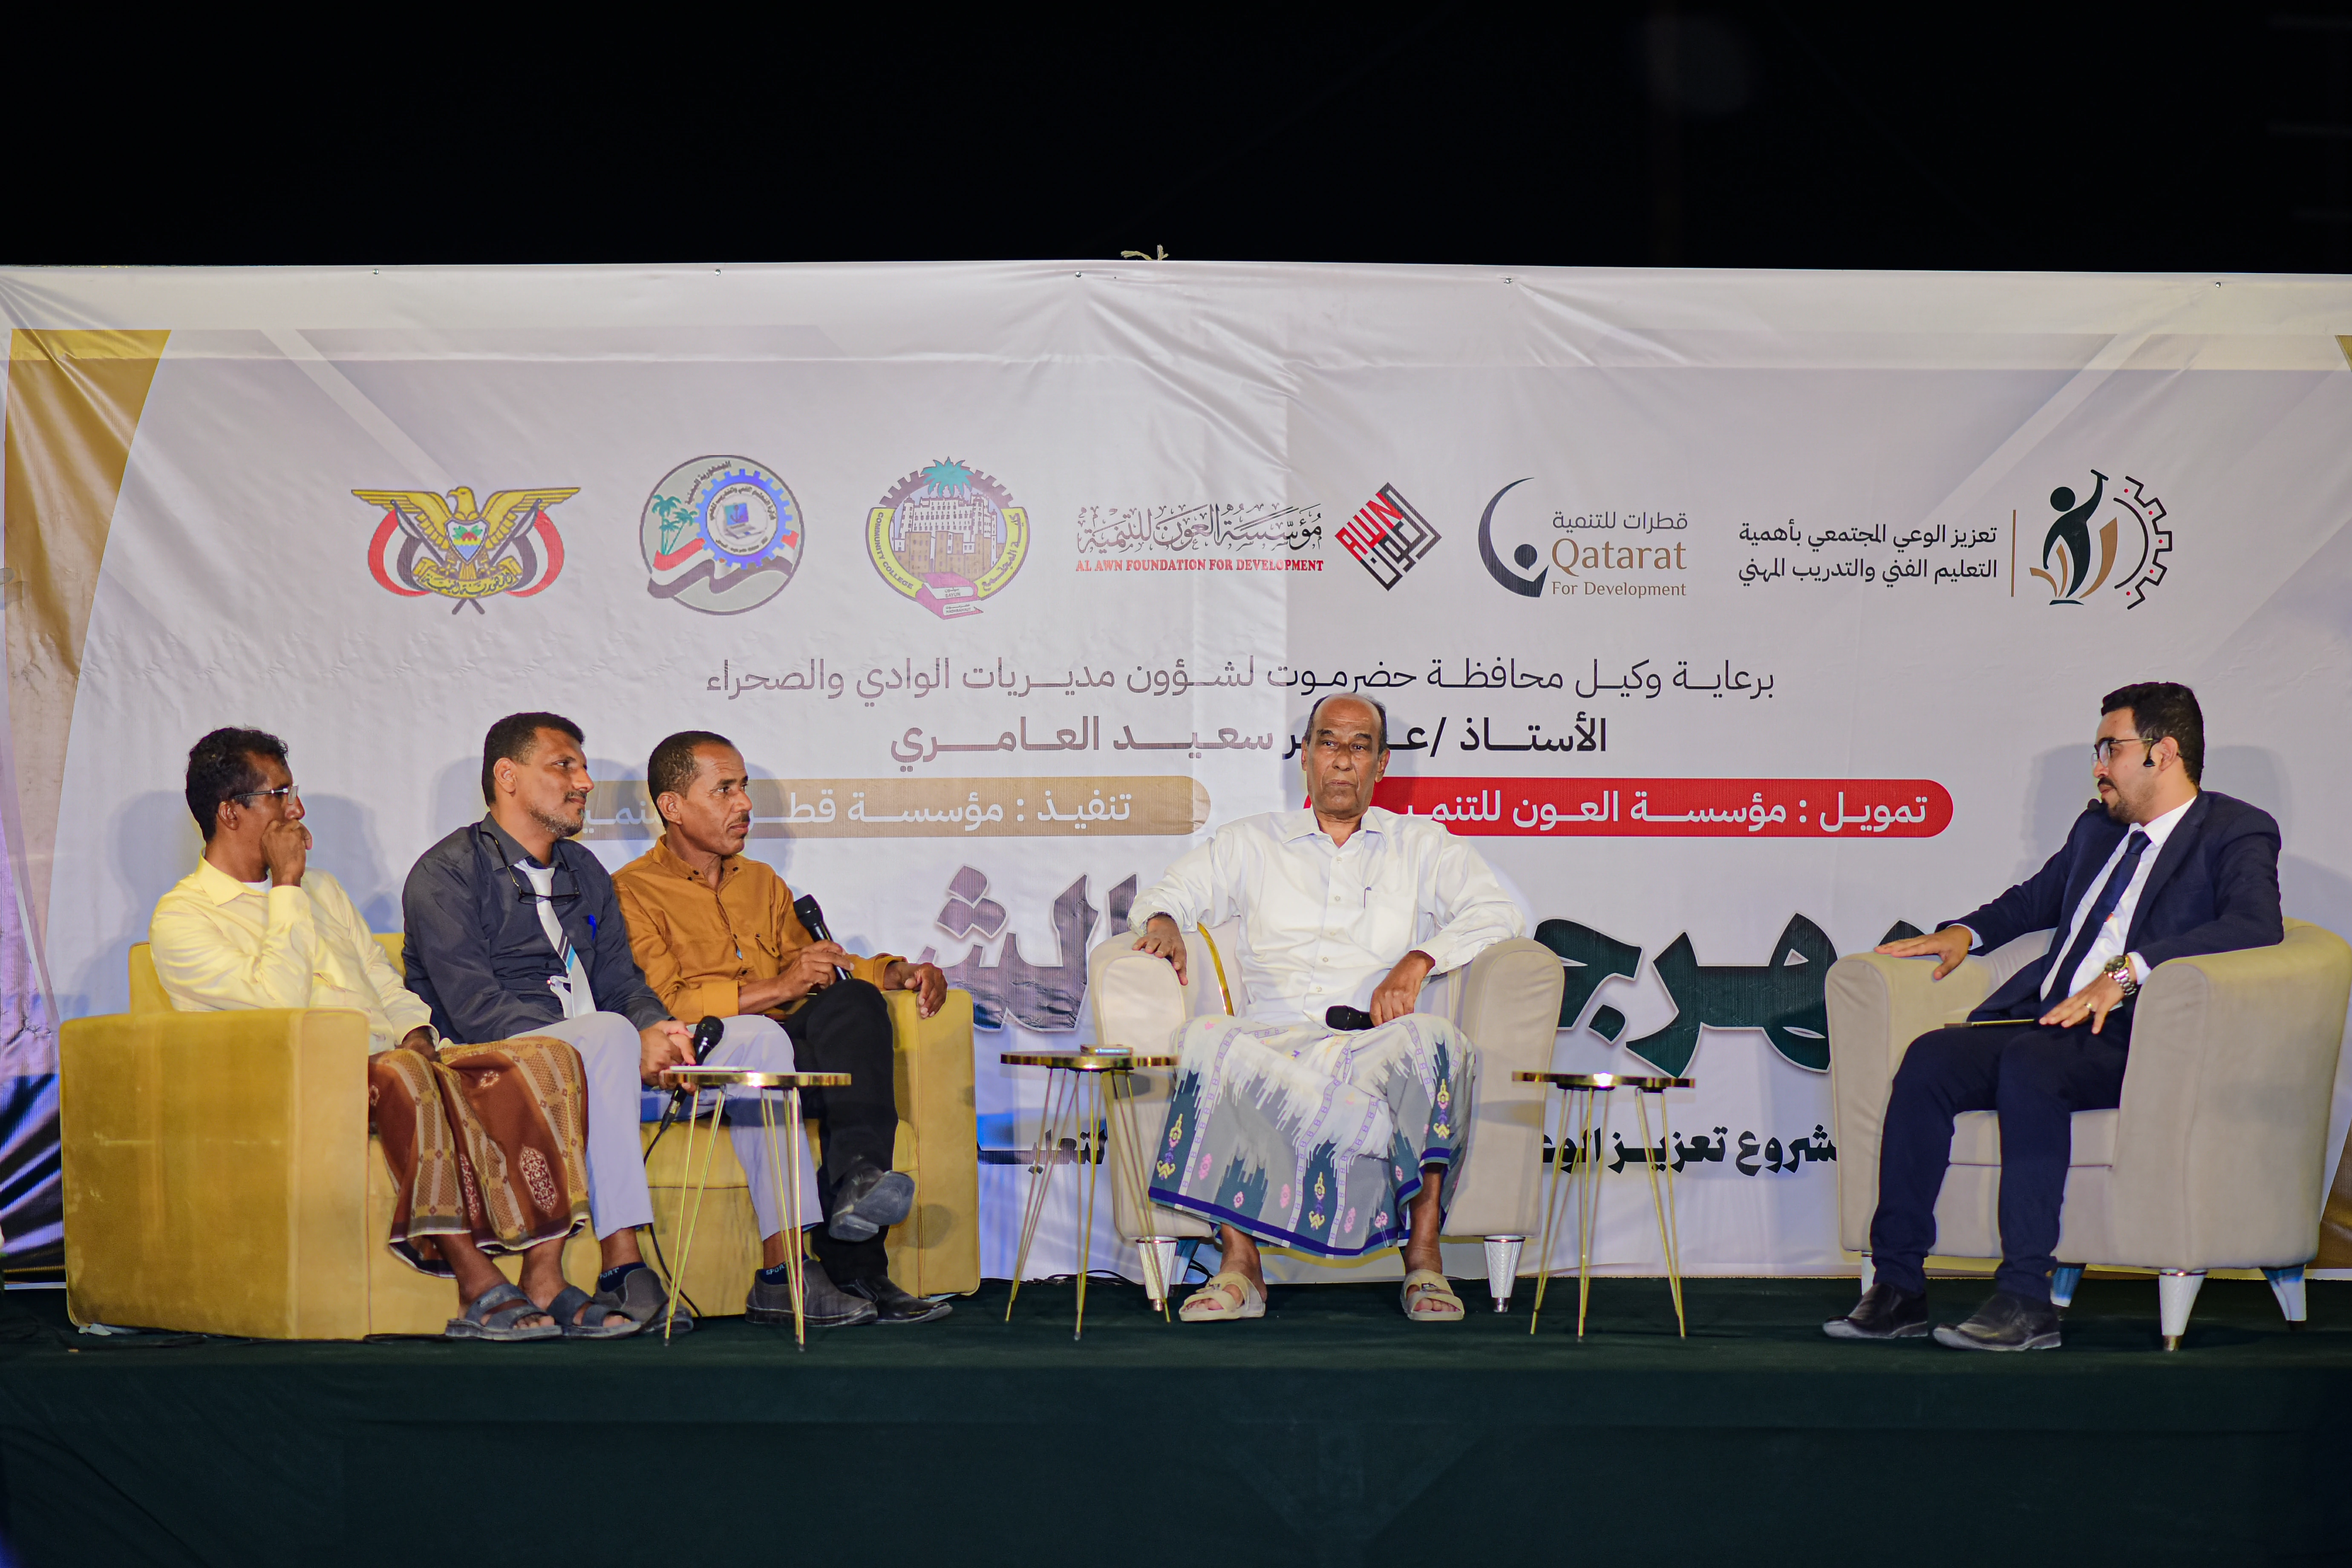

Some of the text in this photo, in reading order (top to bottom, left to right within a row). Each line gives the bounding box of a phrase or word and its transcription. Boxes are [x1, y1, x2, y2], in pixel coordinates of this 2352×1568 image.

[1552, 511, 1687, 534] قطرات للتنمية
[1739, 519, 1997, 553] تعزيز الوعي المجتمعي بأهمية
[874, 512, 914, 589] COMMUNITY COLLEGE
[1076, 559, 1323, 572] AL AWN FOUNDATION FOR DEVELOPMENT
[1552, 538, 1686, 576] Qatarat
[1551, 581, 1686, 598] For Development
[1738, 558, 1997, 588] التعليم الفني والتدريب المهني
[706, 655, 1775, 707] برعاية وكيل محافظة حضرموت لشؤون مديريات الوادي والصحراء
[891, 715, 1100, 772] العامري
[1113, 725, 1273, 759] سعيد
[1460, 712, 1607, 752] الأستاذ
[848, 791, 1003, 832] مؤسسة
[1036, 789, 1132, 829] تنفيذ
[1512, 790, 1618, 831] العون
[1630, 791, 1787, 833] مؤسسة
[1819, 792, 1927, 833] تمويل
[1542, 1124, 1837, 1177] شروع تعزيز الوع
[600, 1267, 619, 1279] PORT
[766, 1262, 786, 1275] SPOR
